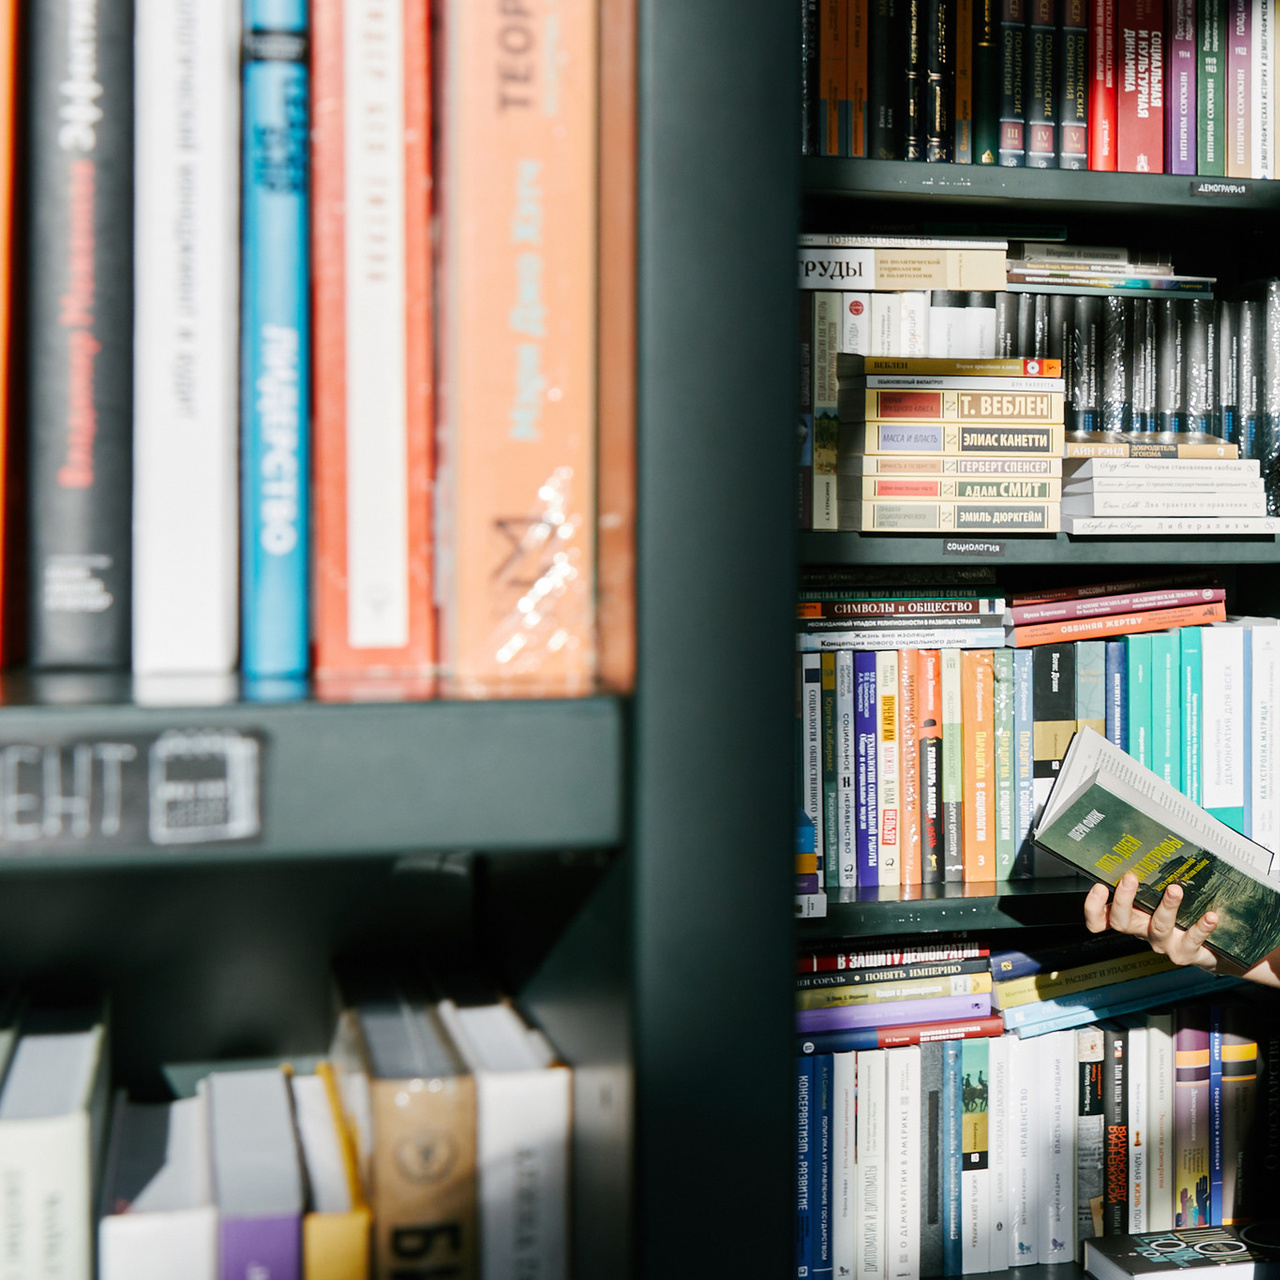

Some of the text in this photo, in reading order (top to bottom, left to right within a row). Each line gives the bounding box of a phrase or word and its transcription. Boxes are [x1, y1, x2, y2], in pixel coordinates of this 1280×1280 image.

[1004, 30, 1013, 95] СОЧИНЕНИЯ
[1014, 32, 1022, 114] ПОЛИТИЧЕСКИЕ
[1034, 33, 1043, 98] СОЧИНЕНИЯ
[1044, 35, 1053, 117] ПОЛИТИЧЕСКИЕ
[1066, 34, 1075, 100] СОЧИНЕНИЯ
[1076, 36, 1085, 118] ПОЛИТИЧЕСКИЕ
[1124, 28, 1136, 92] ДИНАМИКА
[1137, 40, 1149, 118] КУЛЬТУРНАЯ
[1151, 30, 1162, 107] СОЦИАЛЬНАЯ
[1180, 71, 1188, 160] ПИТИРИМ СОРОКИН
[1207, 78, 1215, 162] ПИТИРИМ СОРОКИН
[1237, 69, 1245, 164] ПИТИРИМ СОРОКИН
[827, 235, 933, 247] ПОЗНАВАЯ ОБЩЕСТВО
[874, 361, 908, 370] ВЕБЛЕН
[961, 396, 1048, 416] Т. ВЕБЛЕН
[256, 322, 298, 558] ЛИДЕРСТВО
[882, 434, 939, 444] МАССА ВЛАСТЬ
[961, 461, 1048, 473] ГЕРБЕРТ СПЕНСЕР
[963, 433, 1048, 447] ЭЛИАС КАНЕТТИ
[1073, 445, 1125, 457] АЙН РЭНД
[1145, 463, 1169, 472] Очерки
[960, 511, 1042, 524] ЭМИЛЬ ДЮРКГЕЙМ
[965, 482, 1042, 498] АДАМ СМИТ
[1157, 522, 1250, 532] Либерализм
[834, 602, 974, 614] СИМВОЛЫ ОБЩЕСТВО
[1060, 616, 1143, 634] ОБВИНЯЯ ЖЕРТВУ
[820, 639, 945, 648] Концепция социального
[1225, 664, 1233, 785] ДЕМОКРАТИЯ ВСЕХ
[976, 731, 986, 841] ПАРАДИГМА СОЦИОЛОГИИ
[1000, 731, 1010, 841] ПАРАДИГМА СОЦИОЛОГИИ
[1020, 731, 1030, 841] ПАРАДИГМА СОЦИОЛОГИИ
[1067, 808, 1106, 842] ШЕРИ ФИНК
[1095, 831, 1144, 874] ПЯТЬ ДНЕЙ
[813, 965, 962, 986] СОРАЛЬ ПОНЯТЬ ИМПЕРИЮ
[848, 942, 980, 969] ЗАЩИТУ ДЕМОКРАТИИ
[798, 1075, 808, 1210] КОНСЕРВАТИЗМ РАЗВИТИЕ
[1107, 1124, 1118, 1204] ИСКАЖЕННАЯ
[1118, 1125, 1128, 1202] ДЕМОКРАТИЯ
[864, 1165, 878, 1273] ДИПЛОМАТИЯ ДИПЛОМАТЫ
